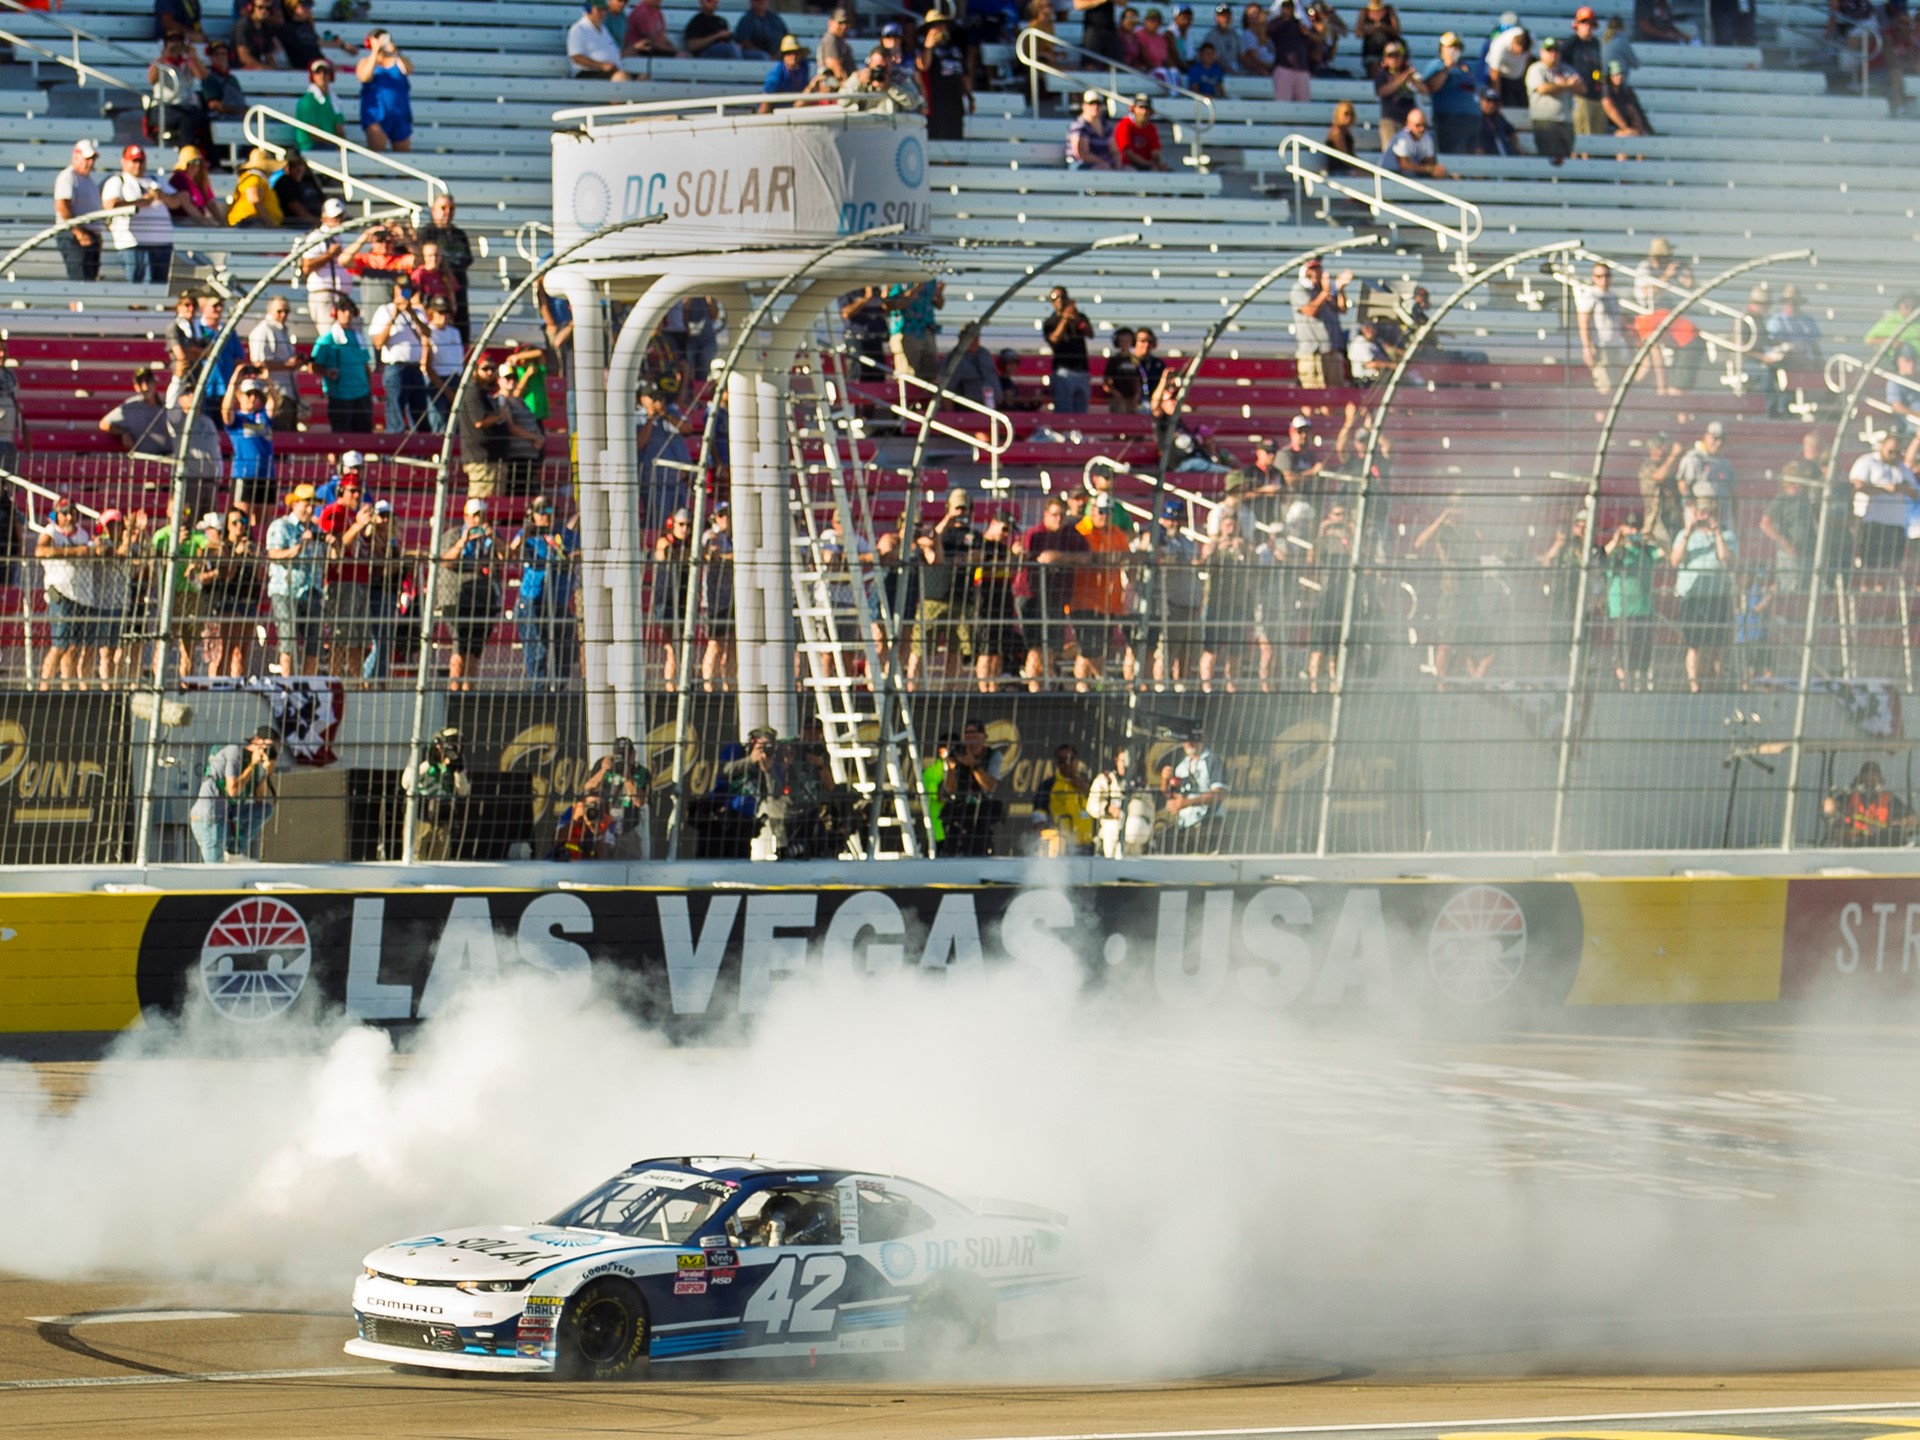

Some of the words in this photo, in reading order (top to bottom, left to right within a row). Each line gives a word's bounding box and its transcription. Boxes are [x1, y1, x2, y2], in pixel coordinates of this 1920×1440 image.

[622, 172, 666, 222] DC
[673, 165, 796, 218] SOLAR
[838, 201, 877, 236] DC
[346, 893, 594, 1020] LAS
[656, 889, 1081, 1015] VEGAS
[1153, 885, 1396, 1006] USA
[924, 1240, 960, 1272] DC
[965, 1235, 1037, 1269] SOLAR
[710, 1277, 732, 1285] MSD
[742, 1252, 849, 1335] 42
[366, 1297, 444, 1314] CAMARO
[526, 1305, 561, 1315] MAHLE
